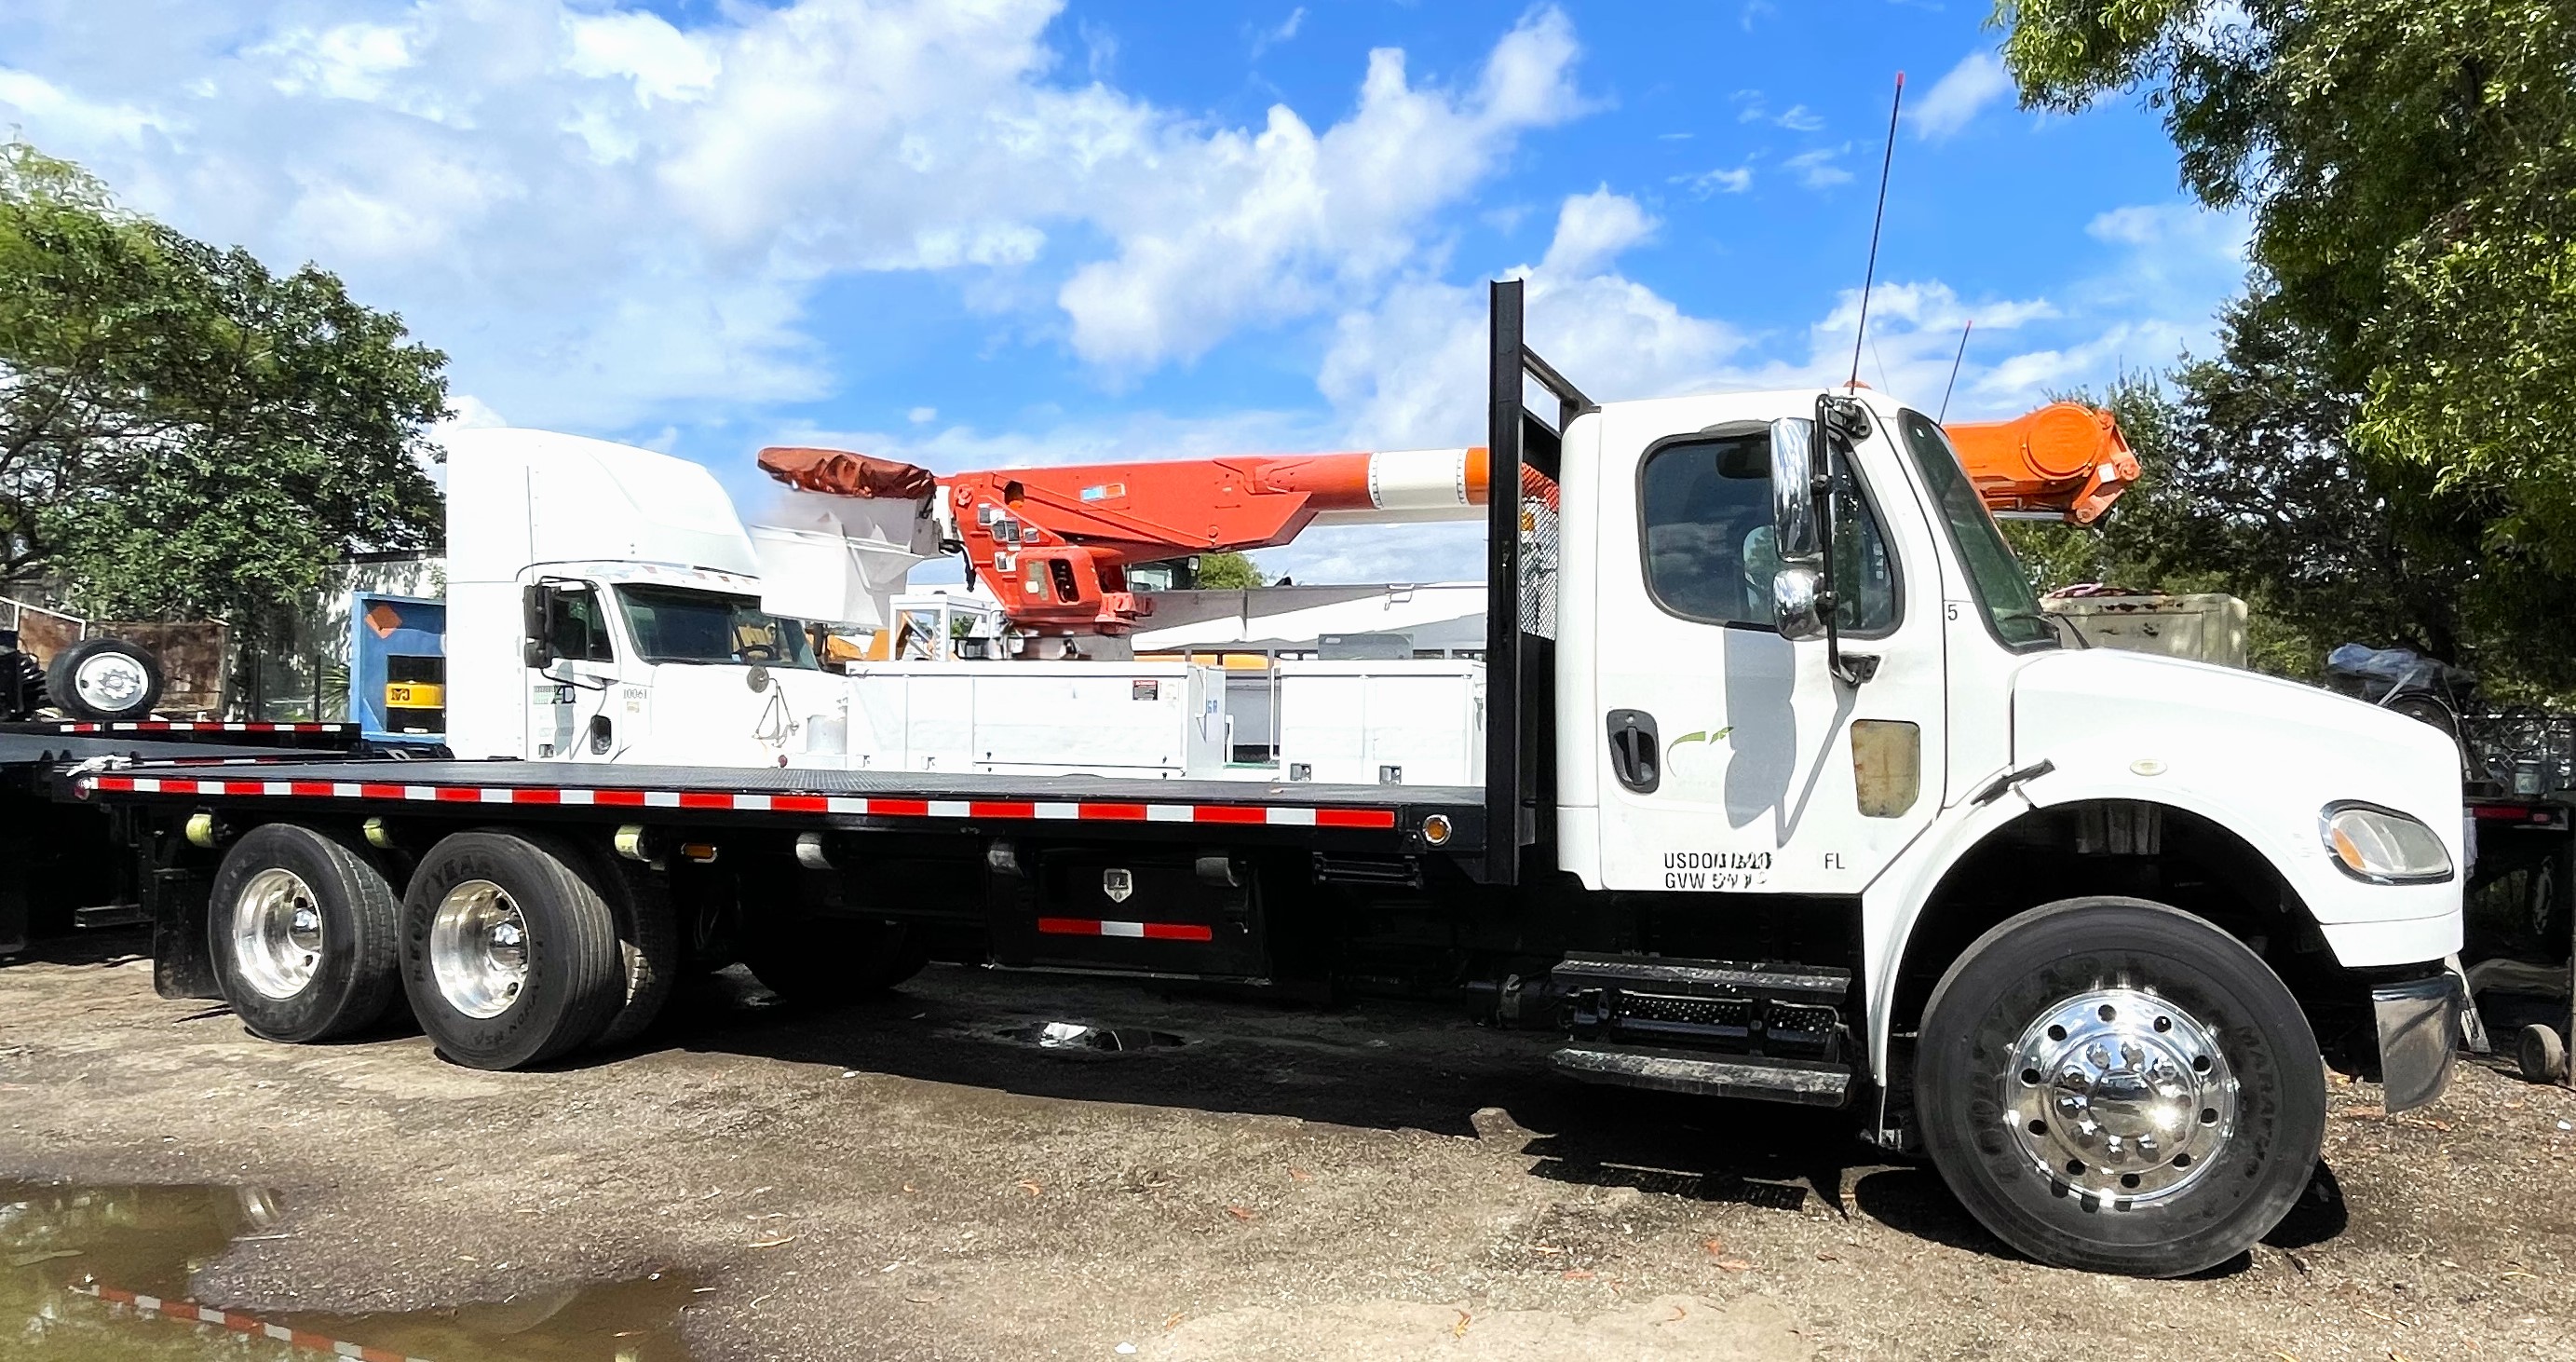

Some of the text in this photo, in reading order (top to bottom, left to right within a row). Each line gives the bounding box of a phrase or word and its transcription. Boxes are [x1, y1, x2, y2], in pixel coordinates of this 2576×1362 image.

[1948, 604, 1958, 620] 5
[623, 688, 647, 700] 10061
[1824, 852, 1846, 869] FL
[1665, 873, 1705, 889] GVW
